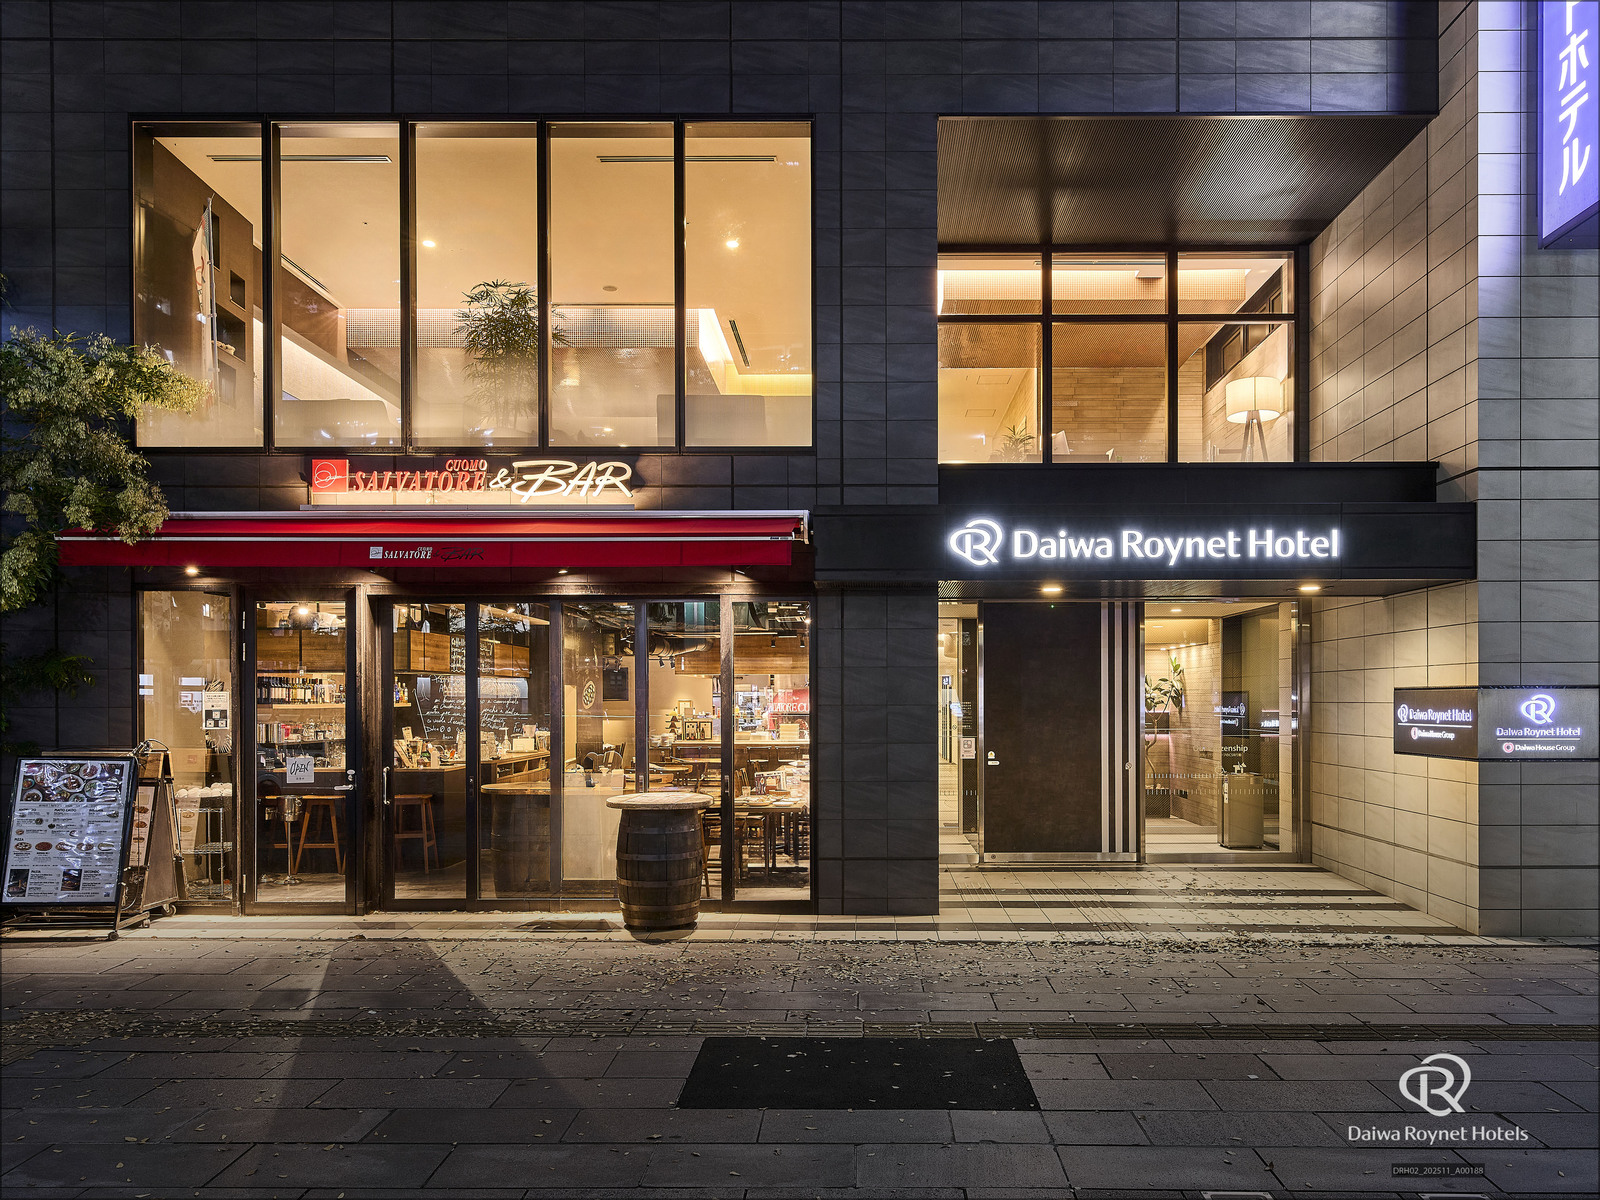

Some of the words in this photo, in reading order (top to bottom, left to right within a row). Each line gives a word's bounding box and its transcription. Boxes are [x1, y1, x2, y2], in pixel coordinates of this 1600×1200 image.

[446, 459, 487, 471] CUOMO
[353, 470, 487, 494] SALVATORE
[489, 468, 512, 489] &
[511, 460, 634, 503] BAR
[384, 550, 432, 559] SALVATORE
[441, 546, 485, 562] BAR
[1013, 530, 1113, 558] Daiwa
[1122, 530, 1240, 566] Roynet
[1248, 529, 1339, 558] Hotel
[1409, 708, 1427, 721] Daiwa
[1428, 708, 1452, 724] Roynet
[1452, 709, 1472, 722] Hotel
[1496, 727, 1523, 736] Daiwa
[1523, 727, 1556, 738] Roynet
[1556, 727, 1581, 736] Hotel
[290, 761, 311, 775] OPEN
